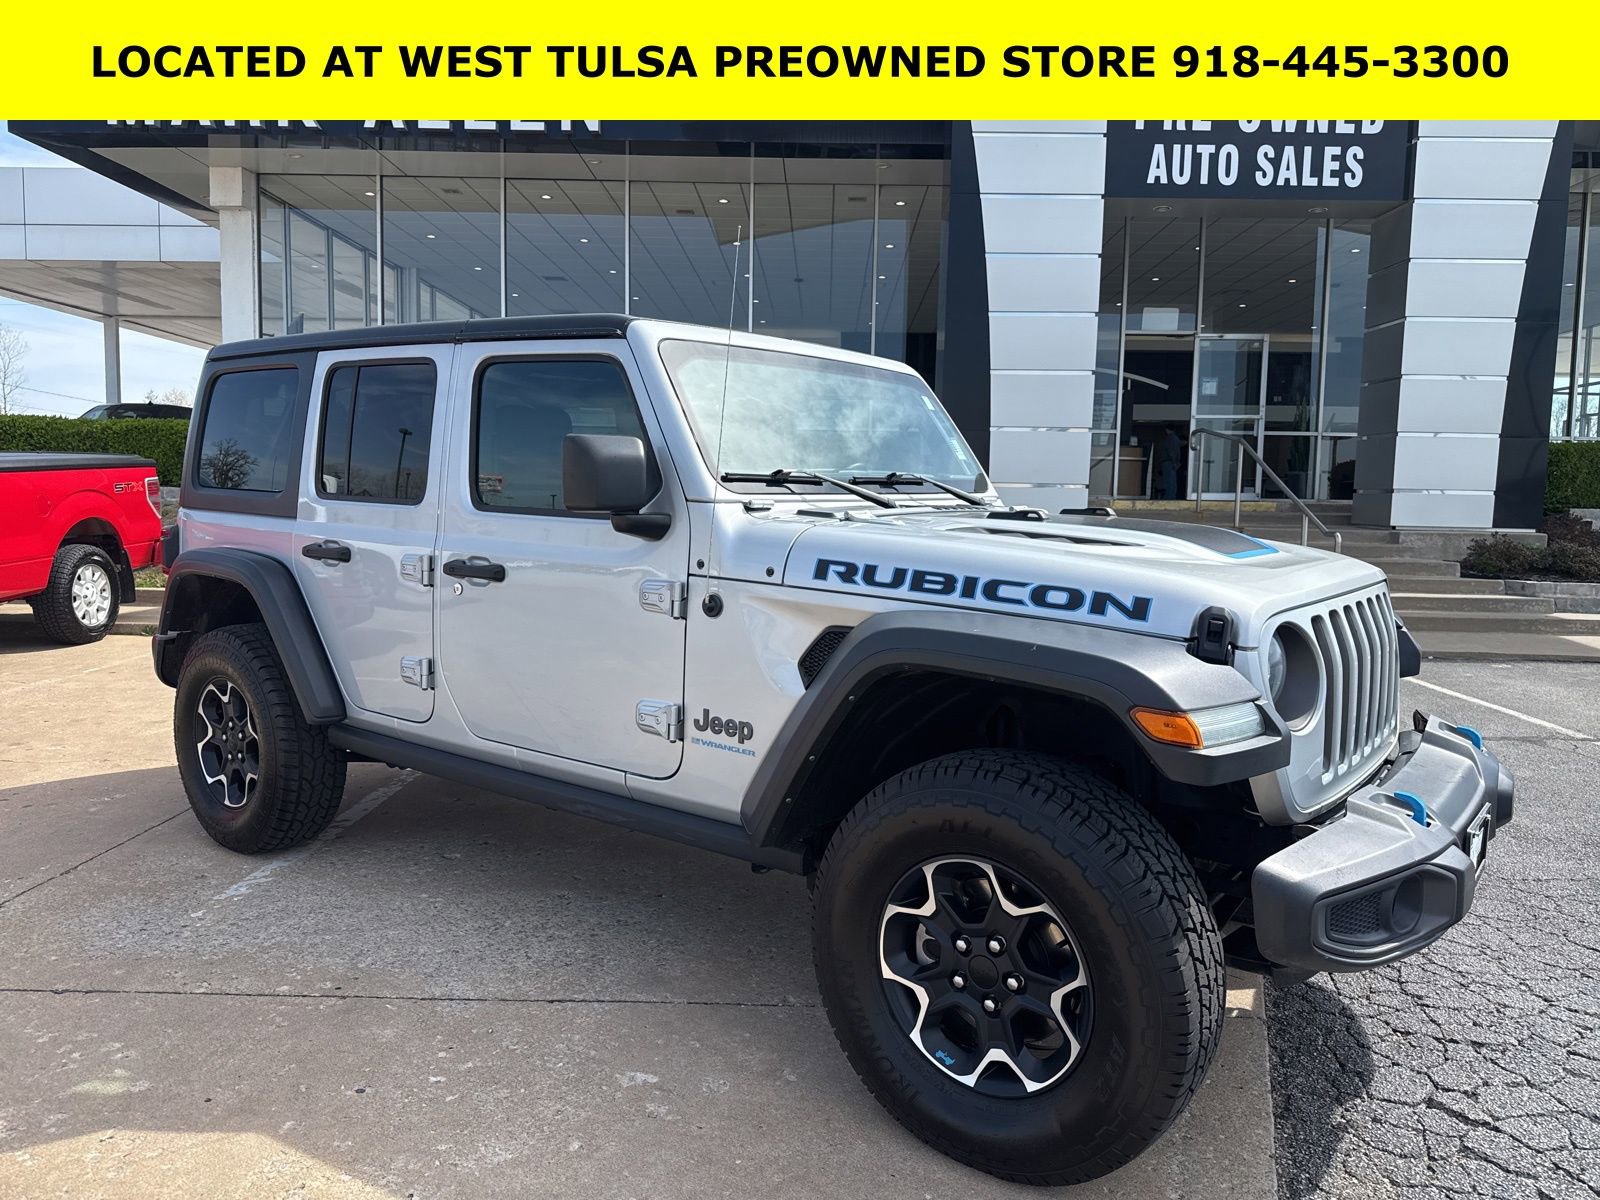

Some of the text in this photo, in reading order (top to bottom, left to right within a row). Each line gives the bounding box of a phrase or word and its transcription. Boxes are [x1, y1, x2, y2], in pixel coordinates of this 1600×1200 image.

[1147, 143, 1365, 188] AUTO SALES
[113, 481, 144, 494] STX
[812, 558, 1154, 623] RUBICON
[693, 708, 754, 744] Jeep
